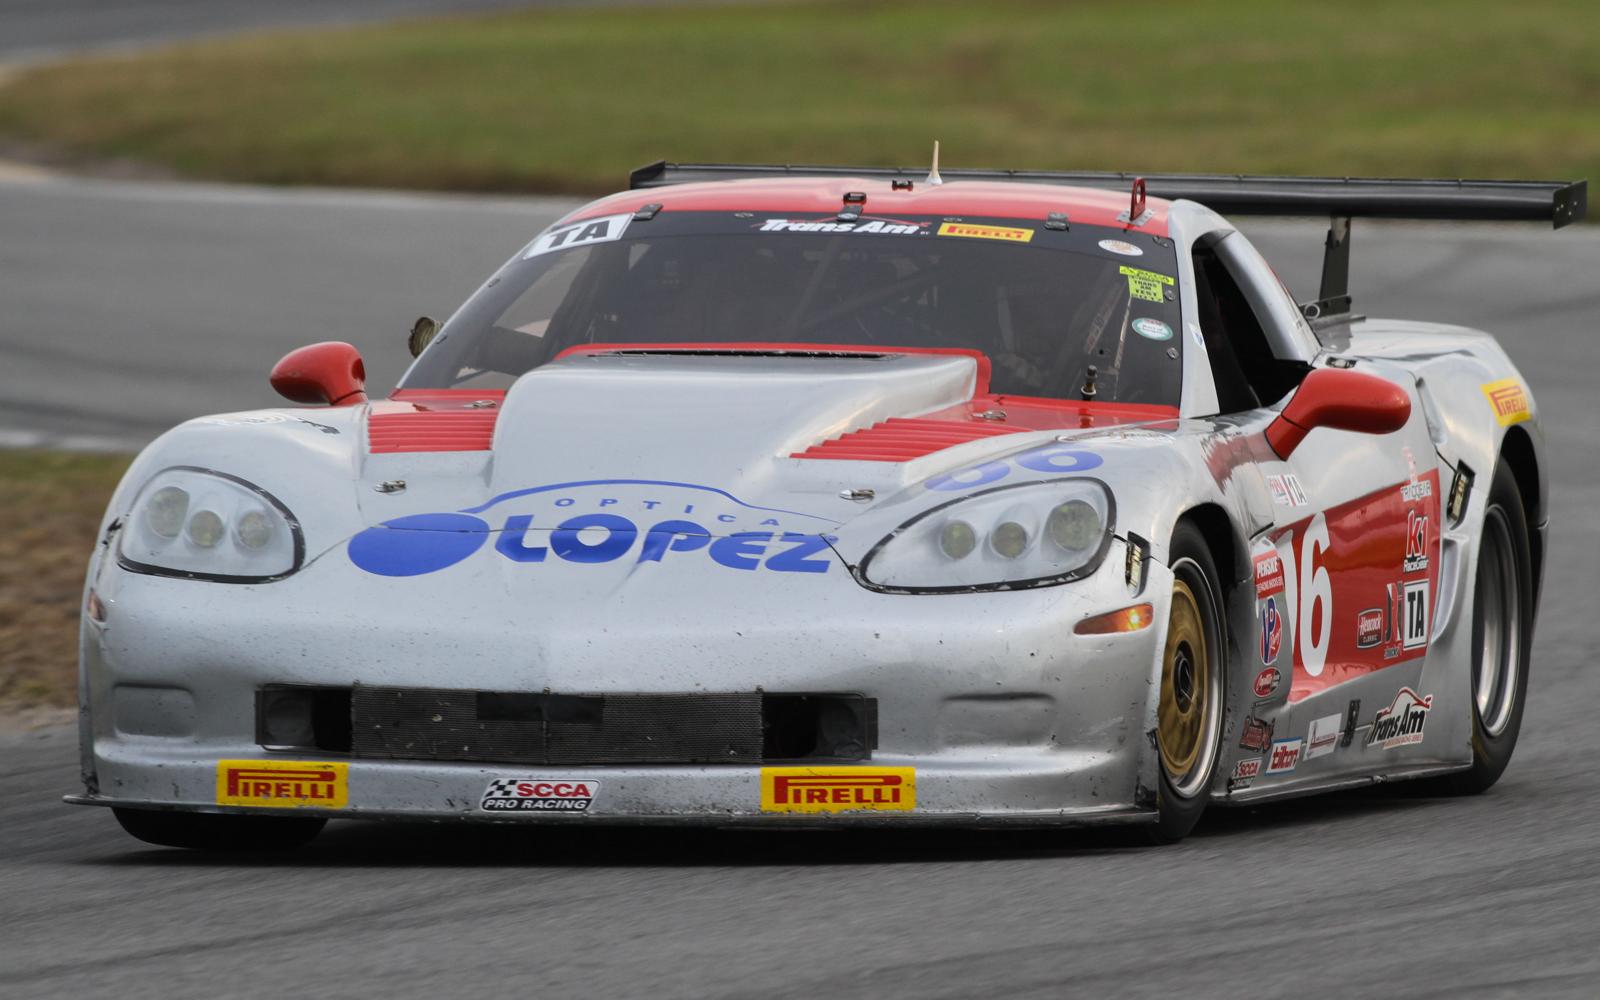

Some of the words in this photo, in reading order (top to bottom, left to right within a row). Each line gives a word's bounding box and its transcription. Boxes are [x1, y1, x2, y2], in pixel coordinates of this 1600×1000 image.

[547, 219, 610, 249] TA
[759, 218, 856, 233] Trans
[851, 220, 921, 235] Am
[554, 497, 781, 527] OPTICA
[494, 512, 838, 574] LOPEZ
[1406, 509, 1429, 559] K1
[1407, 590, 1425, 640] TA
[1368, 712, 1401, 744] Trans
[1396, 702, 1426, 736] Am
[227, 769, 336, 800] PIRELLI
[517, 783, 591, 797] SCCA
[774, 775, 903, 804] PIRELLI
[484, 799, 518, 809] PRO
[520, 799, 588, 810] RACING
